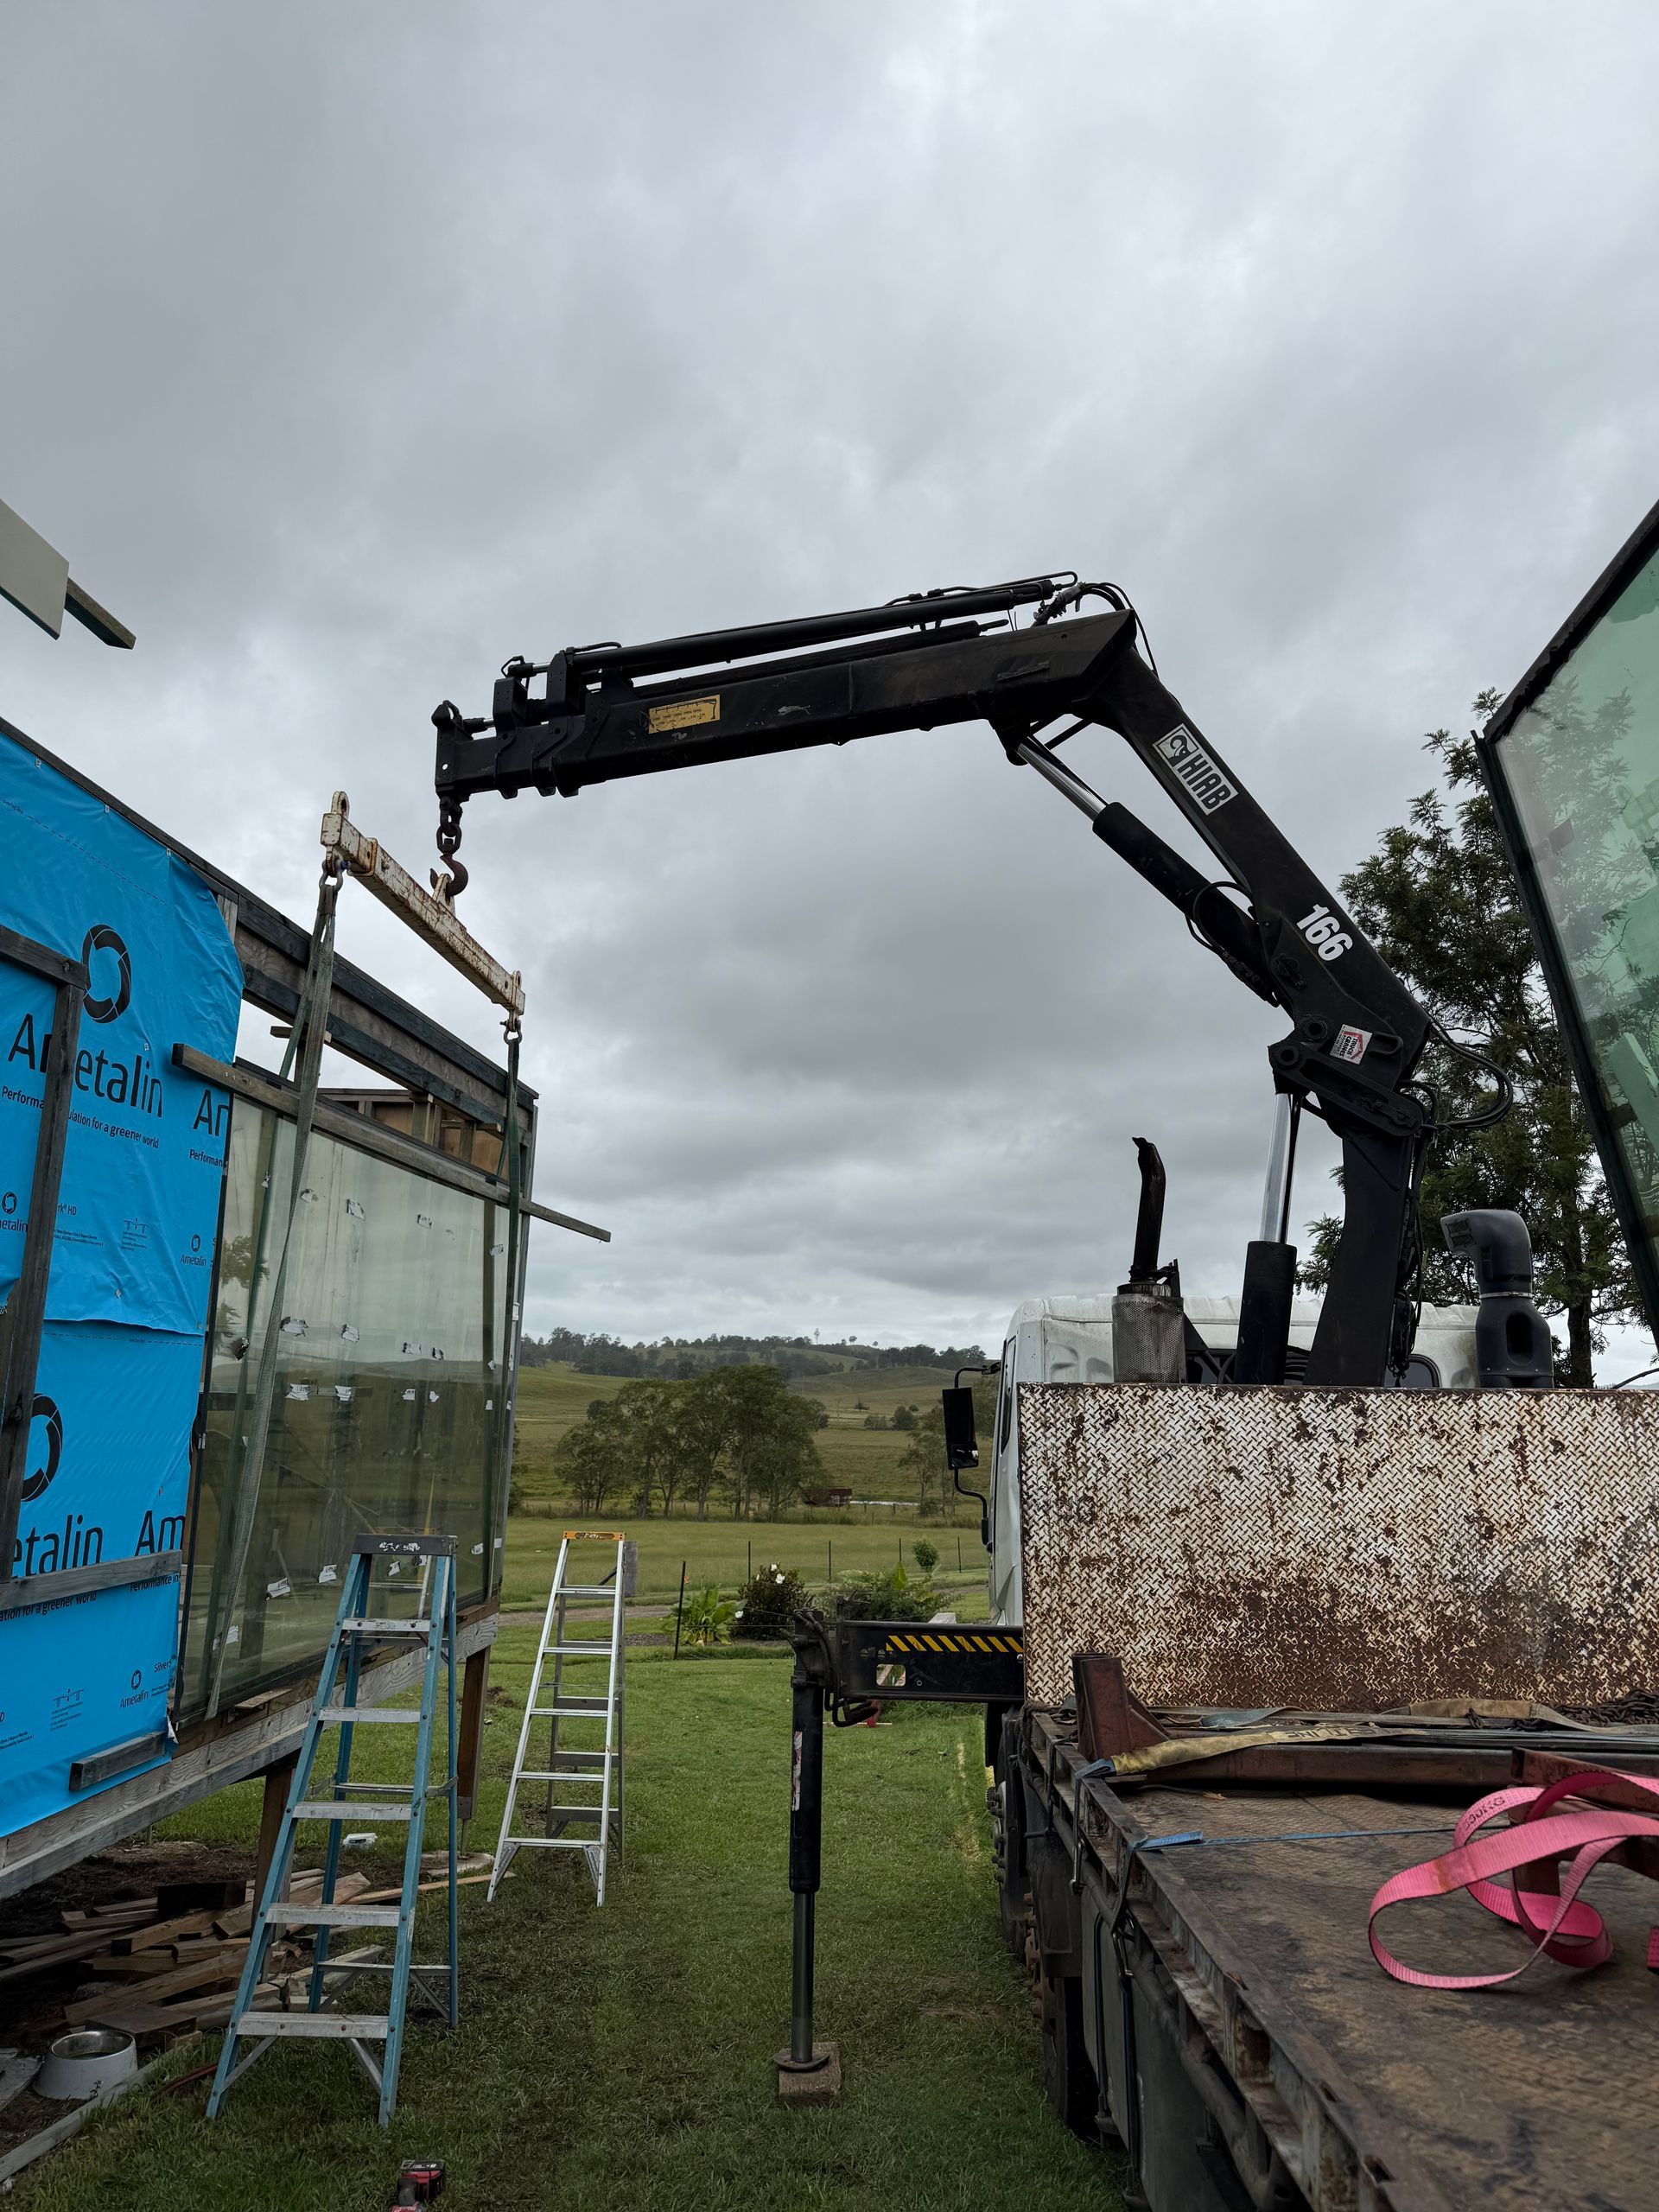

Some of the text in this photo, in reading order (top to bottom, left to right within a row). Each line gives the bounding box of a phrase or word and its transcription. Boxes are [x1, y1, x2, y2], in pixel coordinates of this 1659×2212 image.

[1177, 753, 1231, 810] HIAB
[1296, 904, 1353, 961] 166
[1339, 1036, 1351, 1058] CRANES
[1347, 1038, 1358, 1056] TRUCK
[92, 1116, 103, 1130] for
[104, 1123, 109, 1133] a
[110, 1125, 142, 1141] greener
[143, 1136, 159, 1149] world
[68, 1205, 77, 1216] HD
[180, 1254, 207, 1268] Ametalin
[42, 1596, 74, 1616] greener
[76, 1590, 97, 1605] world
[119, 1690, 149, 1710] Ametalin
